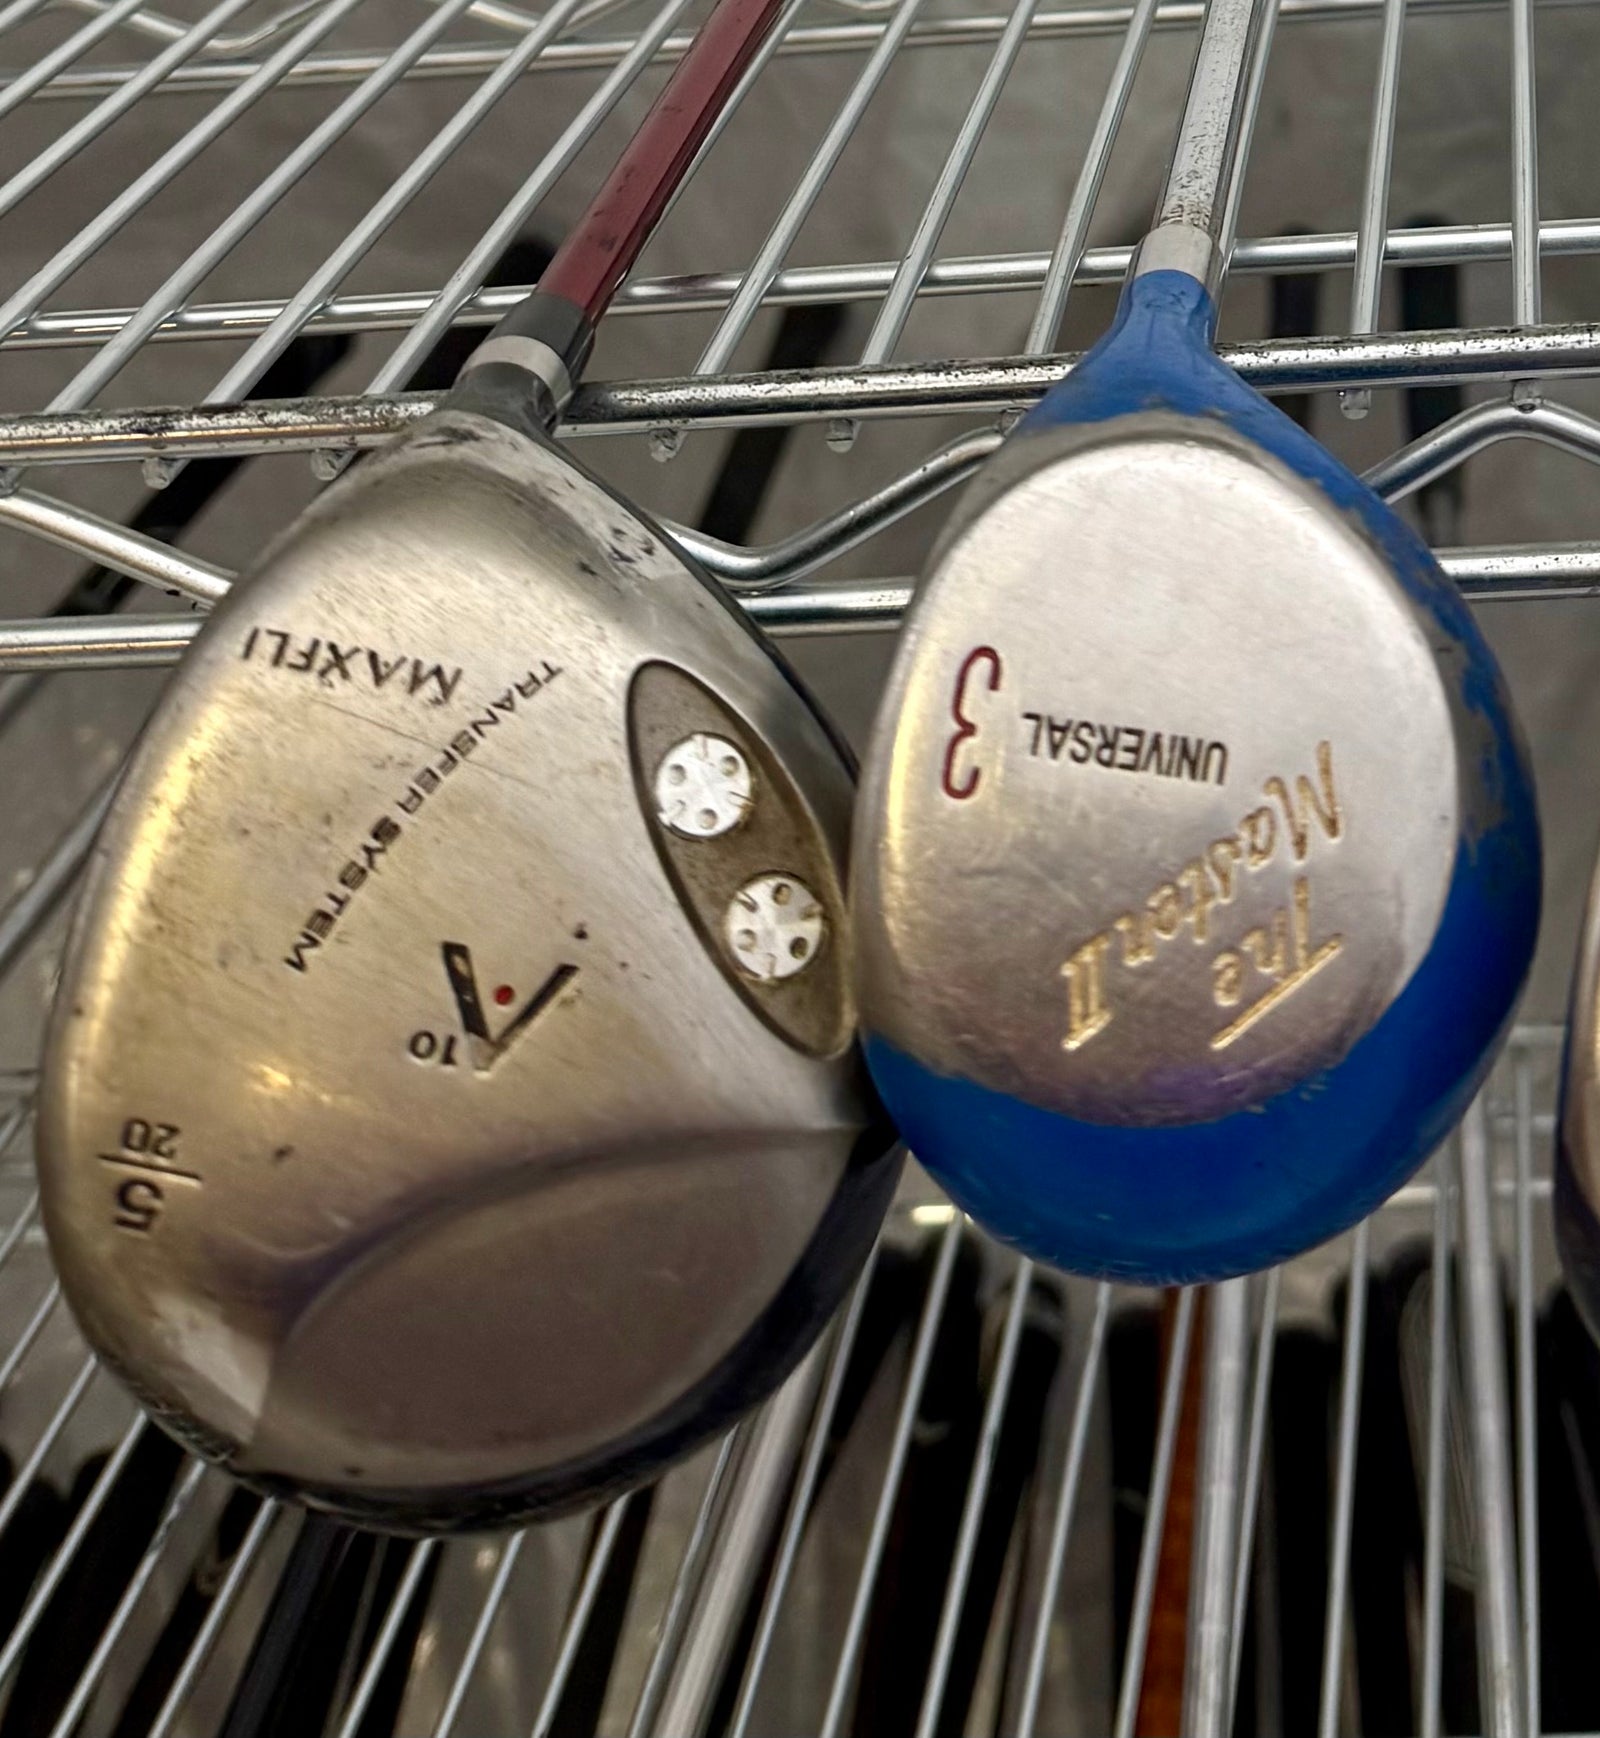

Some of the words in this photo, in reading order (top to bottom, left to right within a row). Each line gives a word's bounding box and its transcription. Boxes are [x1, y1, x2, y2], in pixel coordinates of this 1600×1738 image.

[242, 625, 465, 704] MAXFLI
[396, 659, 564, 815] TRANSFER
[942, 646, 1001, 800] 3
[1022, 711, 1229, 786] UNIVERSAL
[284, 815, 402, 974] SYSTEM
[1113, 740, 1341, 967] Master
[1211, 876, 1345, 1051] The
[112, 1178, 166, 1234] 5
[120, 1118, 181, 1160] 20
